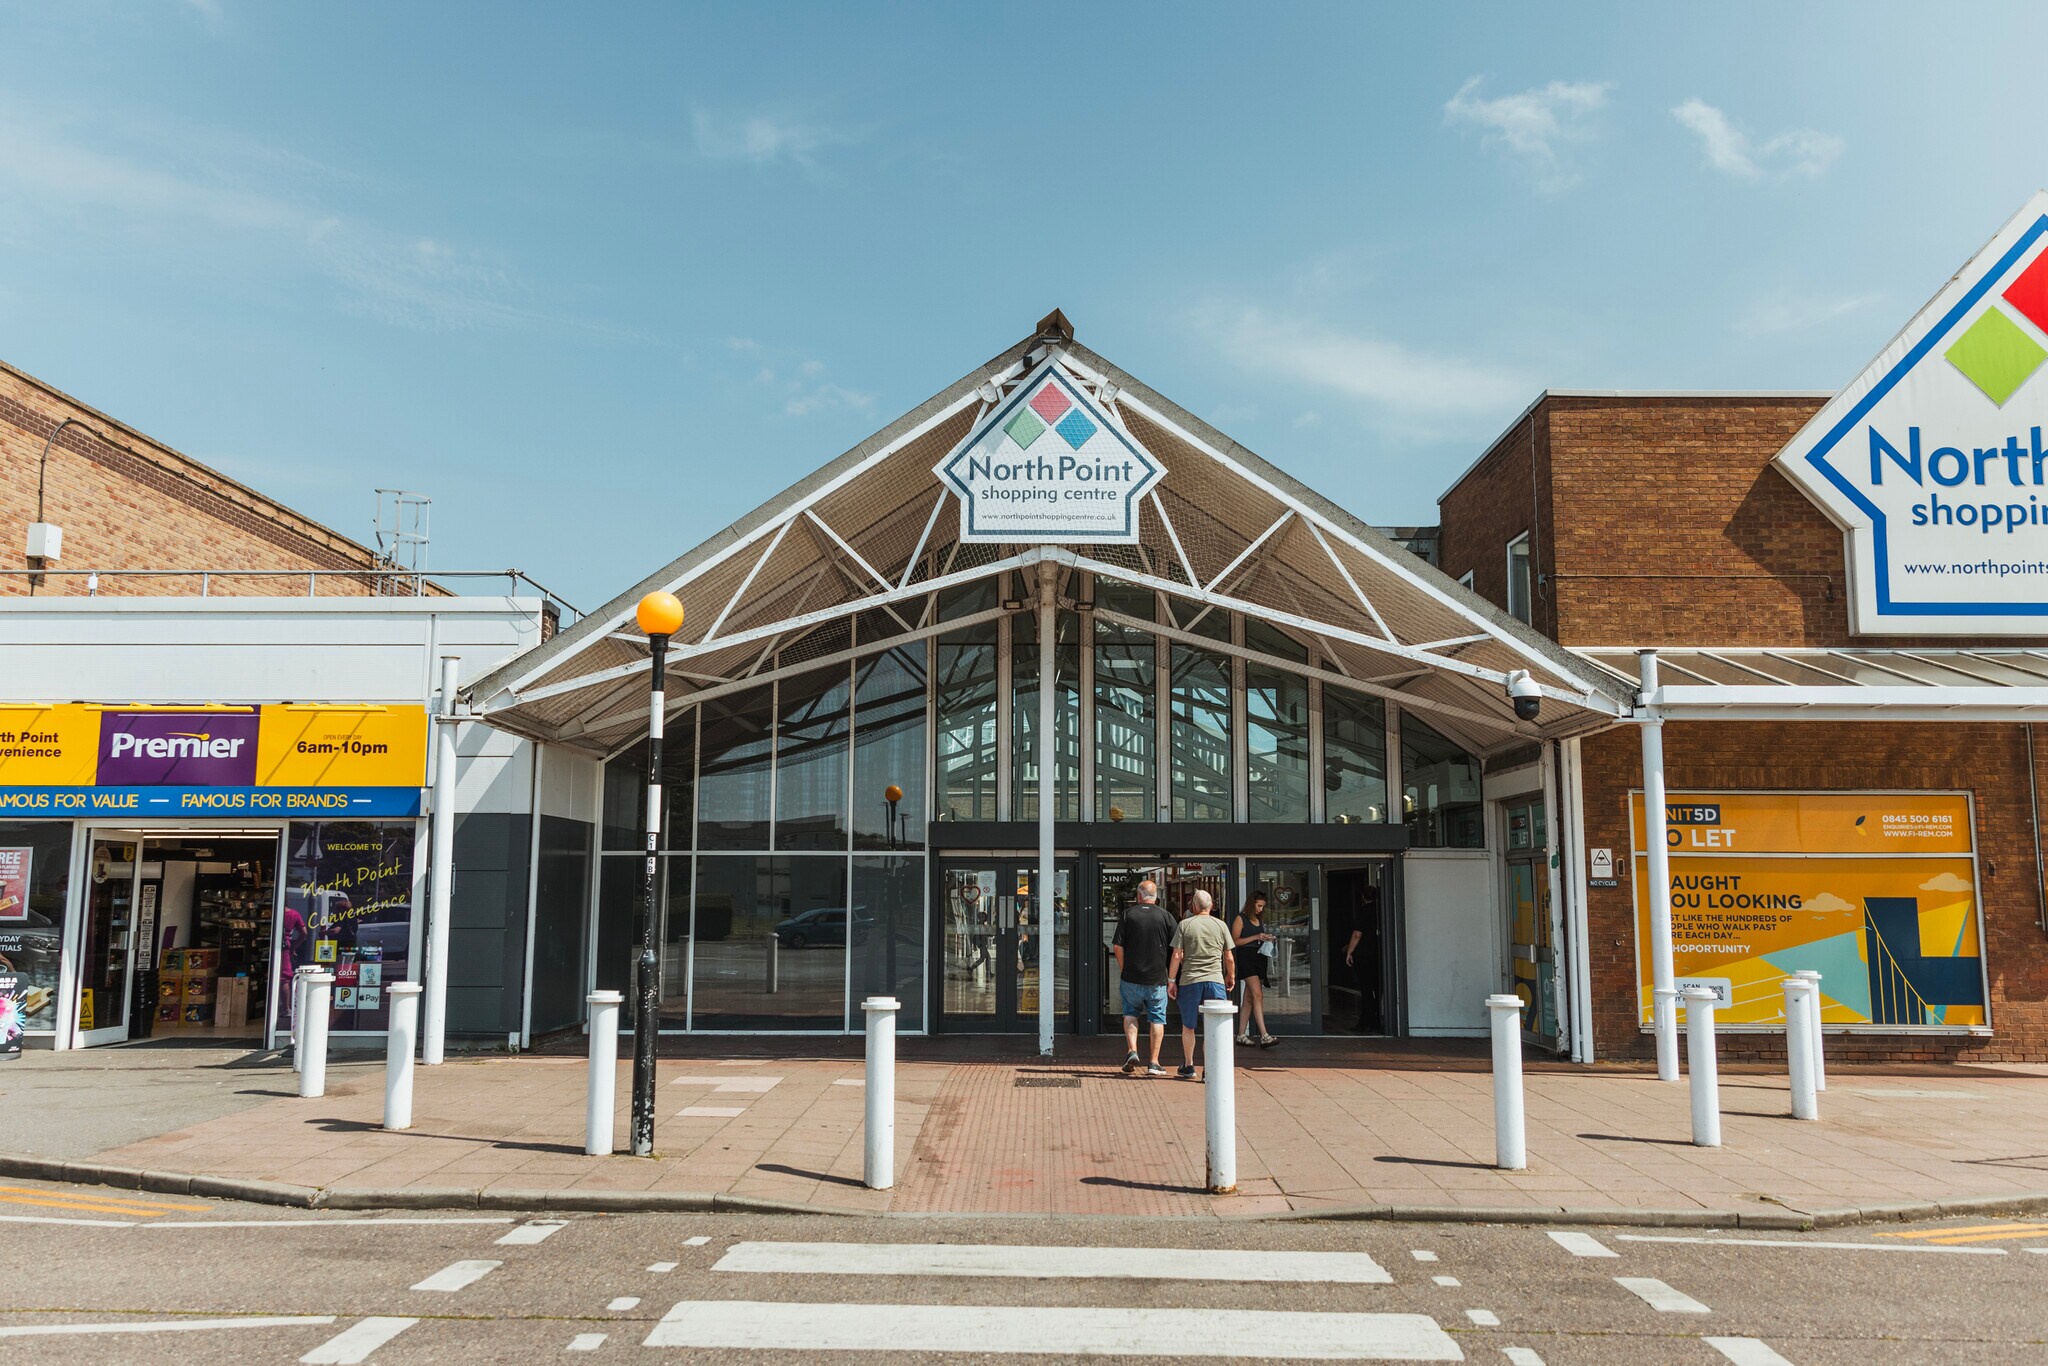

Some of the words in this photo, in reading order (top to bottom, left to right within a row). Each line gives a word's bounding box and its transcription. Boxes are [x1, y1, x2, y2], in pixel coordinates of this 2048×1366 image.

[1868, 425, 2048, 487] North
[969, 455, 1054, 482] North
[1059, 456, 1133, 482] Point
[981, 485, 1057, 503] shopping
[1064, 487, 1117, 501] centre
[981, 512, 1117, 522] www.northpointshoppingcentre.co.uk
[20, 732, 59, 743] Point
[111, 733, 245, 758] Premier
[297, 741, 388, 756] 6am-10pm
[54, 794, 86, 808] FOR
[91, 794, 139, 808] VALUE
[181, 794, 245, 808] FAMOUS
[250, 794, 282, 808] FOR
[286, 794, 348, 808] BRANDS
[1665, 808, 1717, 821] NIT5D
[1882, 815, 1907, 823] 0845
[1909, 815, 1929, 823] 500
[1932, 815, 1952, 823] 6161
[1667, 829, 1682, 846] O
[1691, 829, 1736, 847] LET
[301, 873, 353, 898] North
[357, 857, 402, 885] Point
[1671, 876, 1741, 890] AUGHT
[1671, 894, 1700, 908] OU
[1708, 894, 1802, 909] LOOKING
[308, 895, 406, 929] Convenience
[1673, 944, 1750, 953] HOPORTUNITY
[366, 994, 379, 1003] Pay
